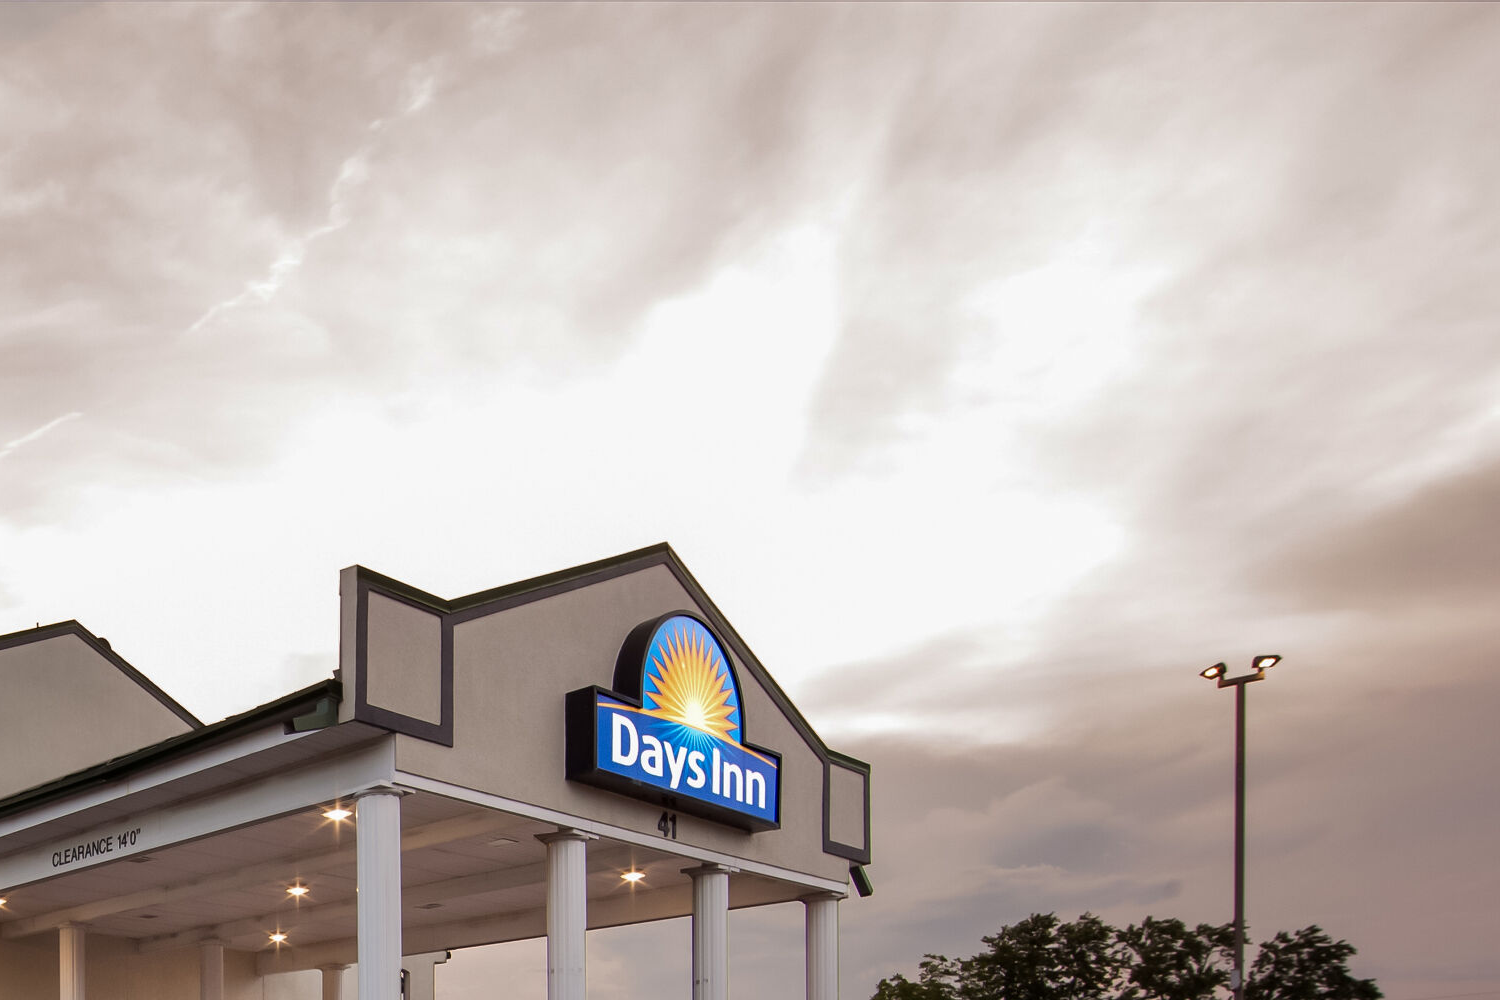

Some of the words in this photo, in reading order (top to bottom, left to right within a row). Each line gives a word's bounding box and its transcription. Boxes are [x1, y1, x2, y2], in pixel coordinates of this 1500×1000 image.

[612, 713, 706, 789] Days
[712, 747, 766, 809] Inn
[657, 811, 677, 839] 41
[52, 836, 113, 867] CLEARANCE
